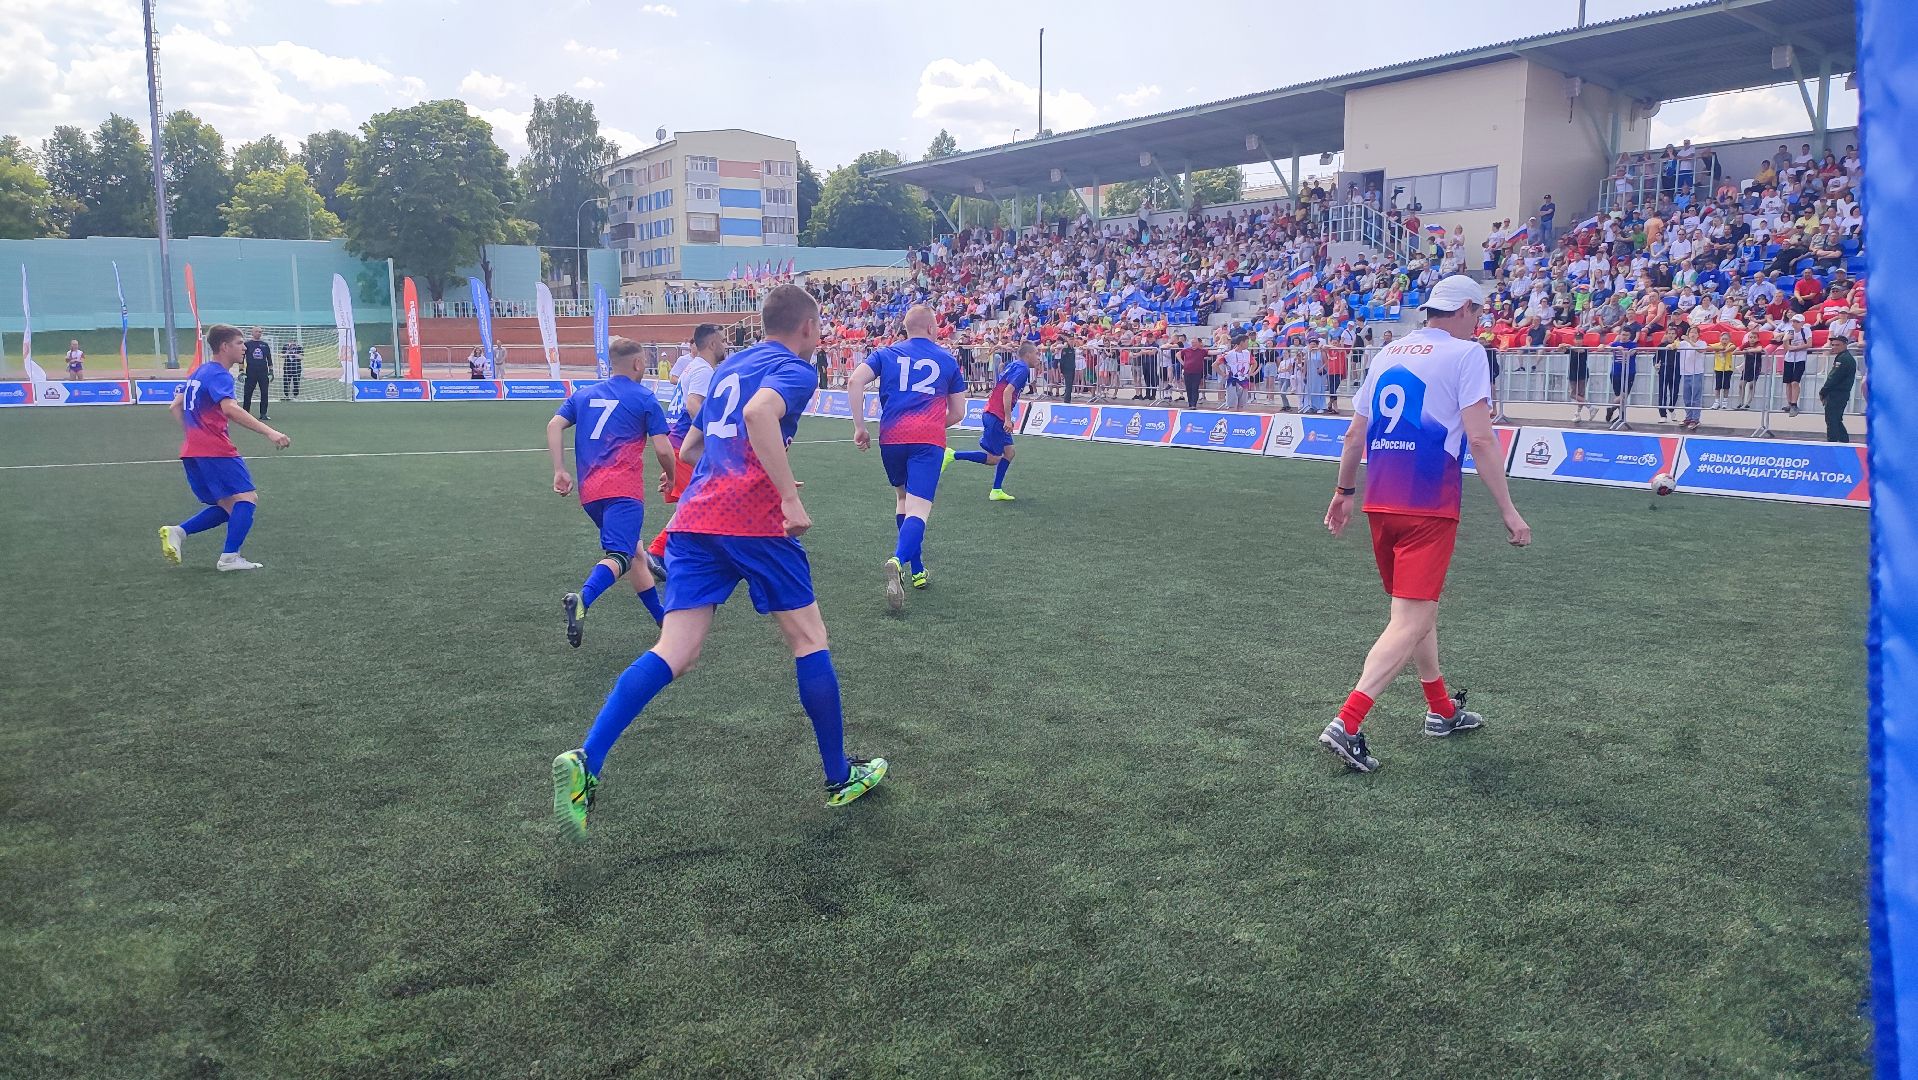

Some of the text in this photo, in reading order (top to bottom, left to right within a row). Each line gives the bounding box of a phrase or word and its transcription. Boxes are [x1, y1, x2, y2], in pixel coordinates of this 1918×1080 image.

[1386, 344, 1433, 356] ТИТОВ
[897, 356, 940, 395] 12
[589, 399, 619, 439] 7
[706, 372, 740, 438] 2
[1379, 384, 1405, 434] 9
[1696, 463, 1853, 484] #КОМАНДАГУБЕРНАТОРА
[1699, 452, 1810, 469] #ВЫХОДИВОДВОР
